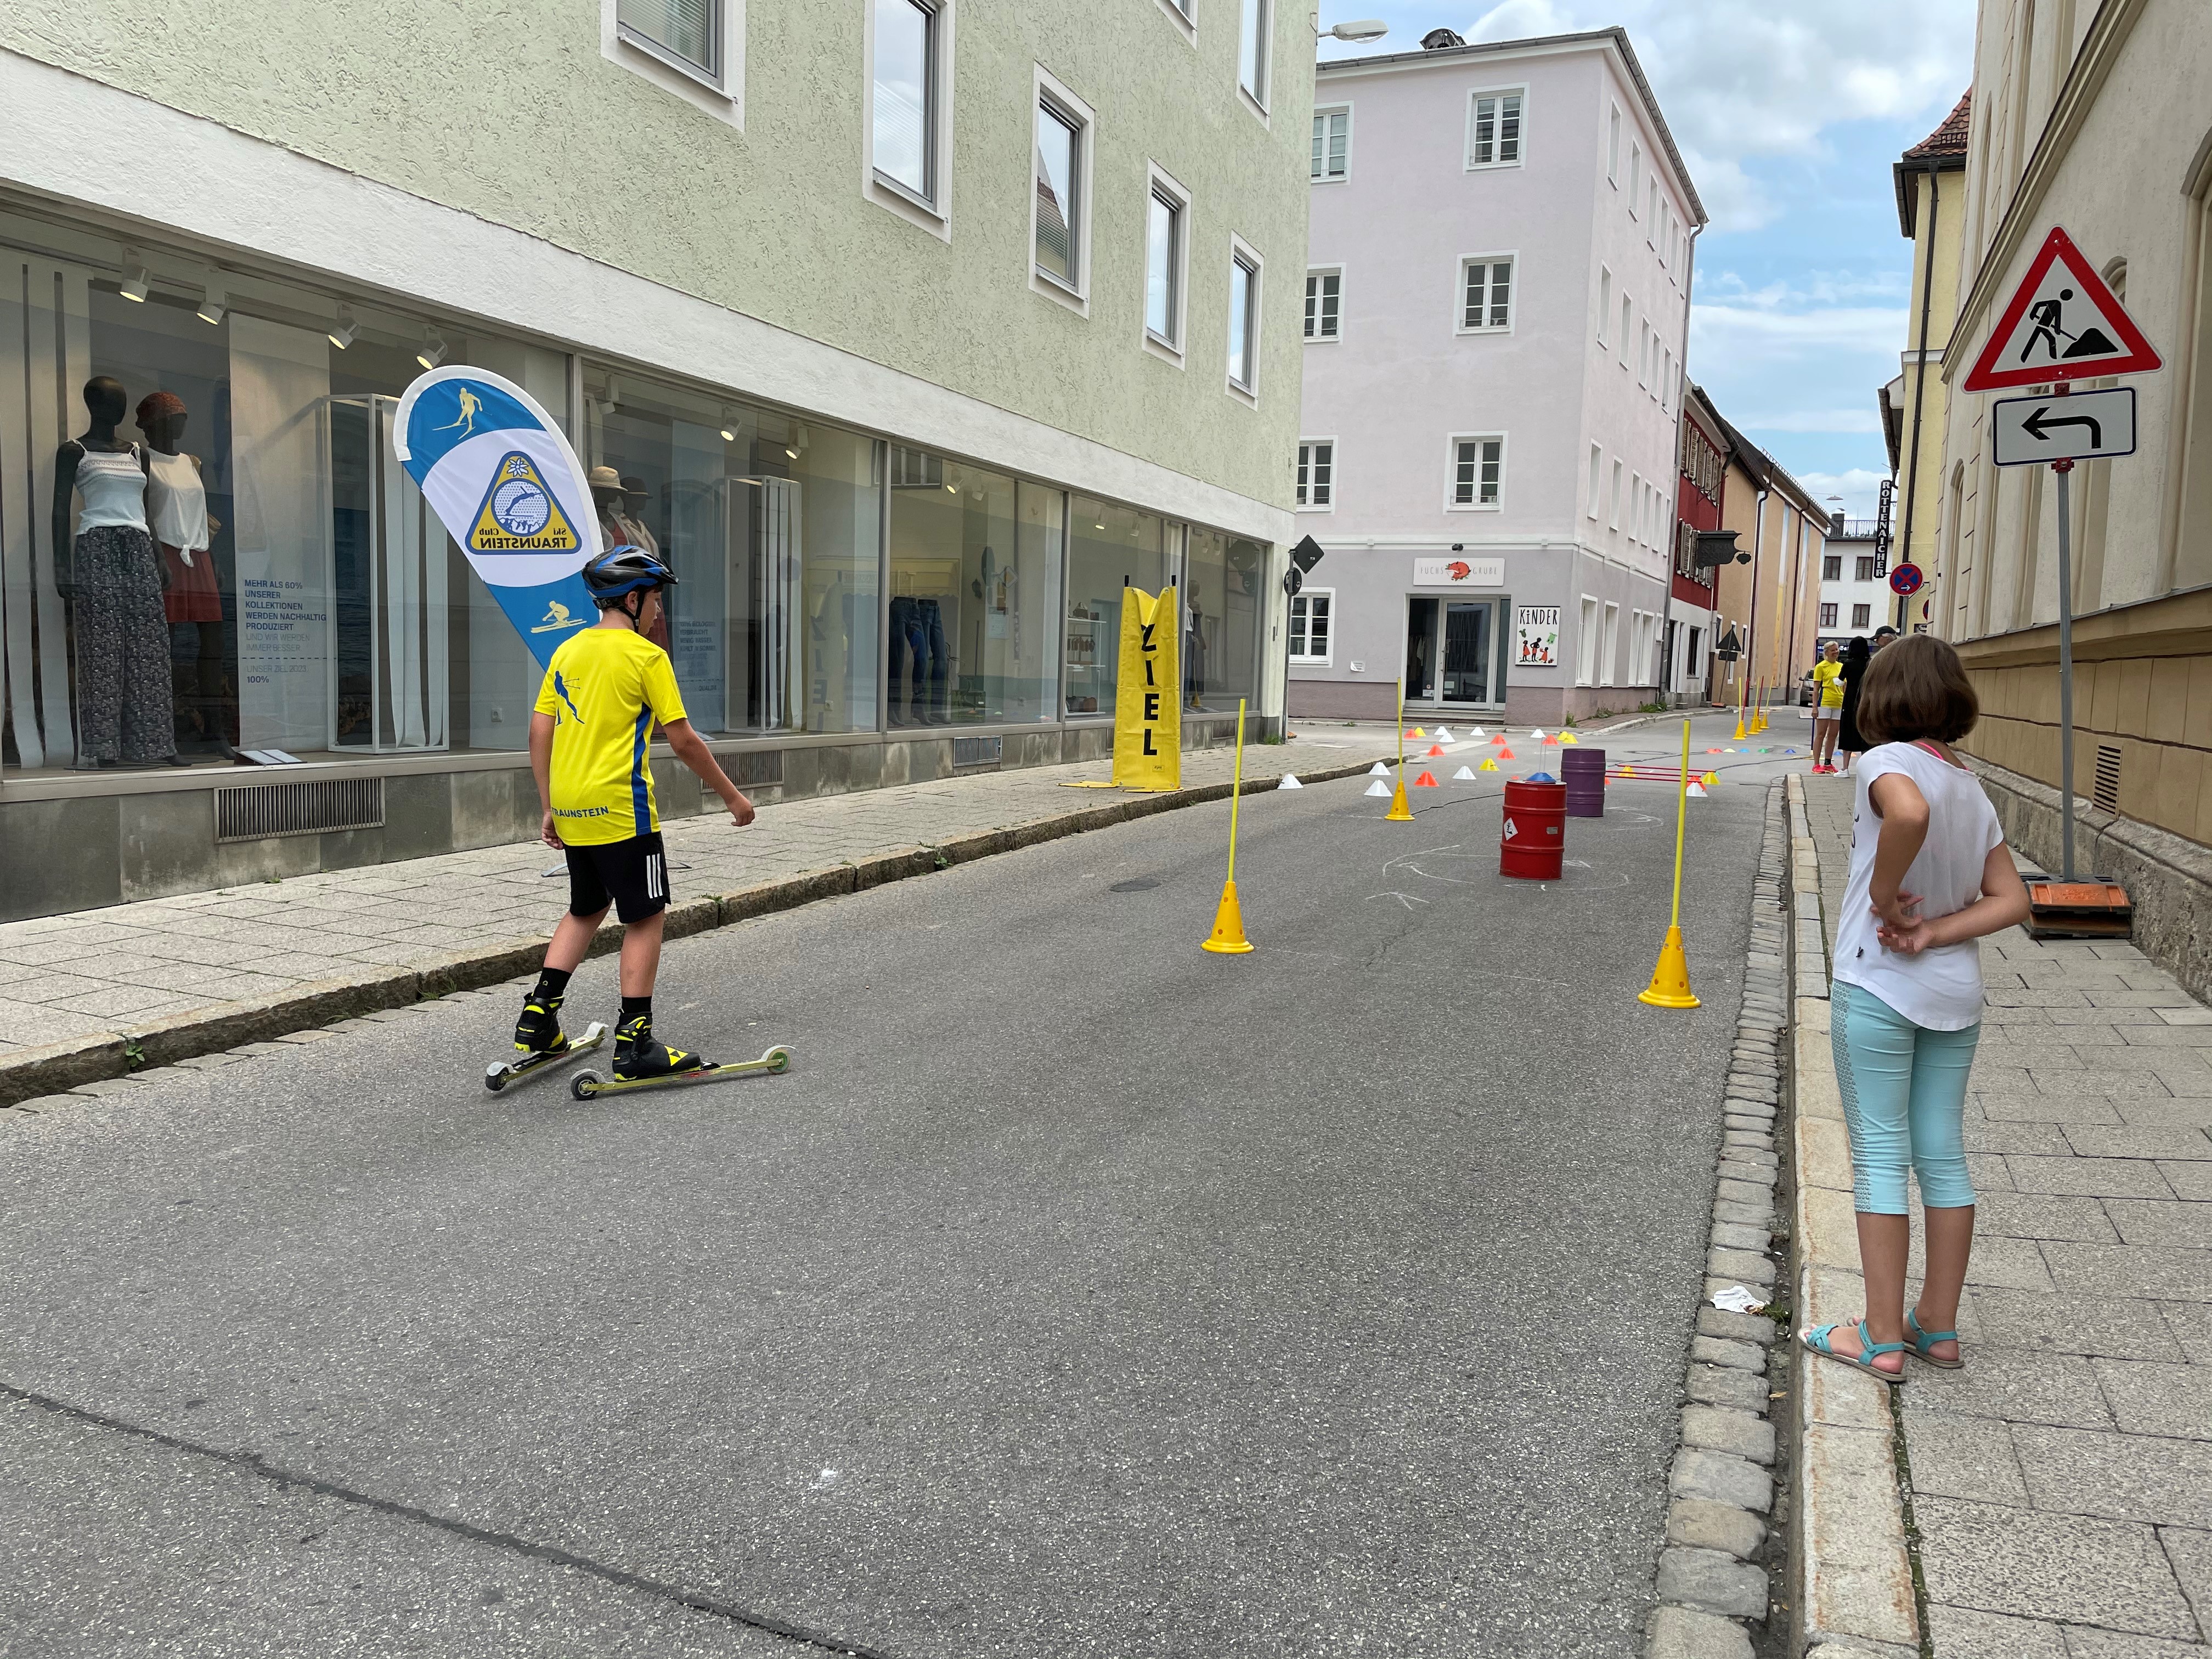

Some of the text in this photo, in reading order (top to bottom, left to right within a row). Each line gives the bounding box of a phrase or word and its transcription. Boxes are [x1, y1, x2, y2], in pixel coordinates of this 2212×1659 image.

[1875, 481, 1891, 577] ROTTENAICHER
[1472, 567, 1497, 575] GRUBE
[245, 579, 268, 588] MEHR
[269, 580, 283, 589] ALS
[245, 590, 281, 599] UNSERER
[245, 601, 303, 610] KOLLEKTIONEN
[245, 612, 326, 621] WERDEN NACHHALTIG
[246, 623, 294, 631] PRODUZIERT
[246, 644, 272, 652] IMMER
[1141, 623, 1160, 756] ZIEL
